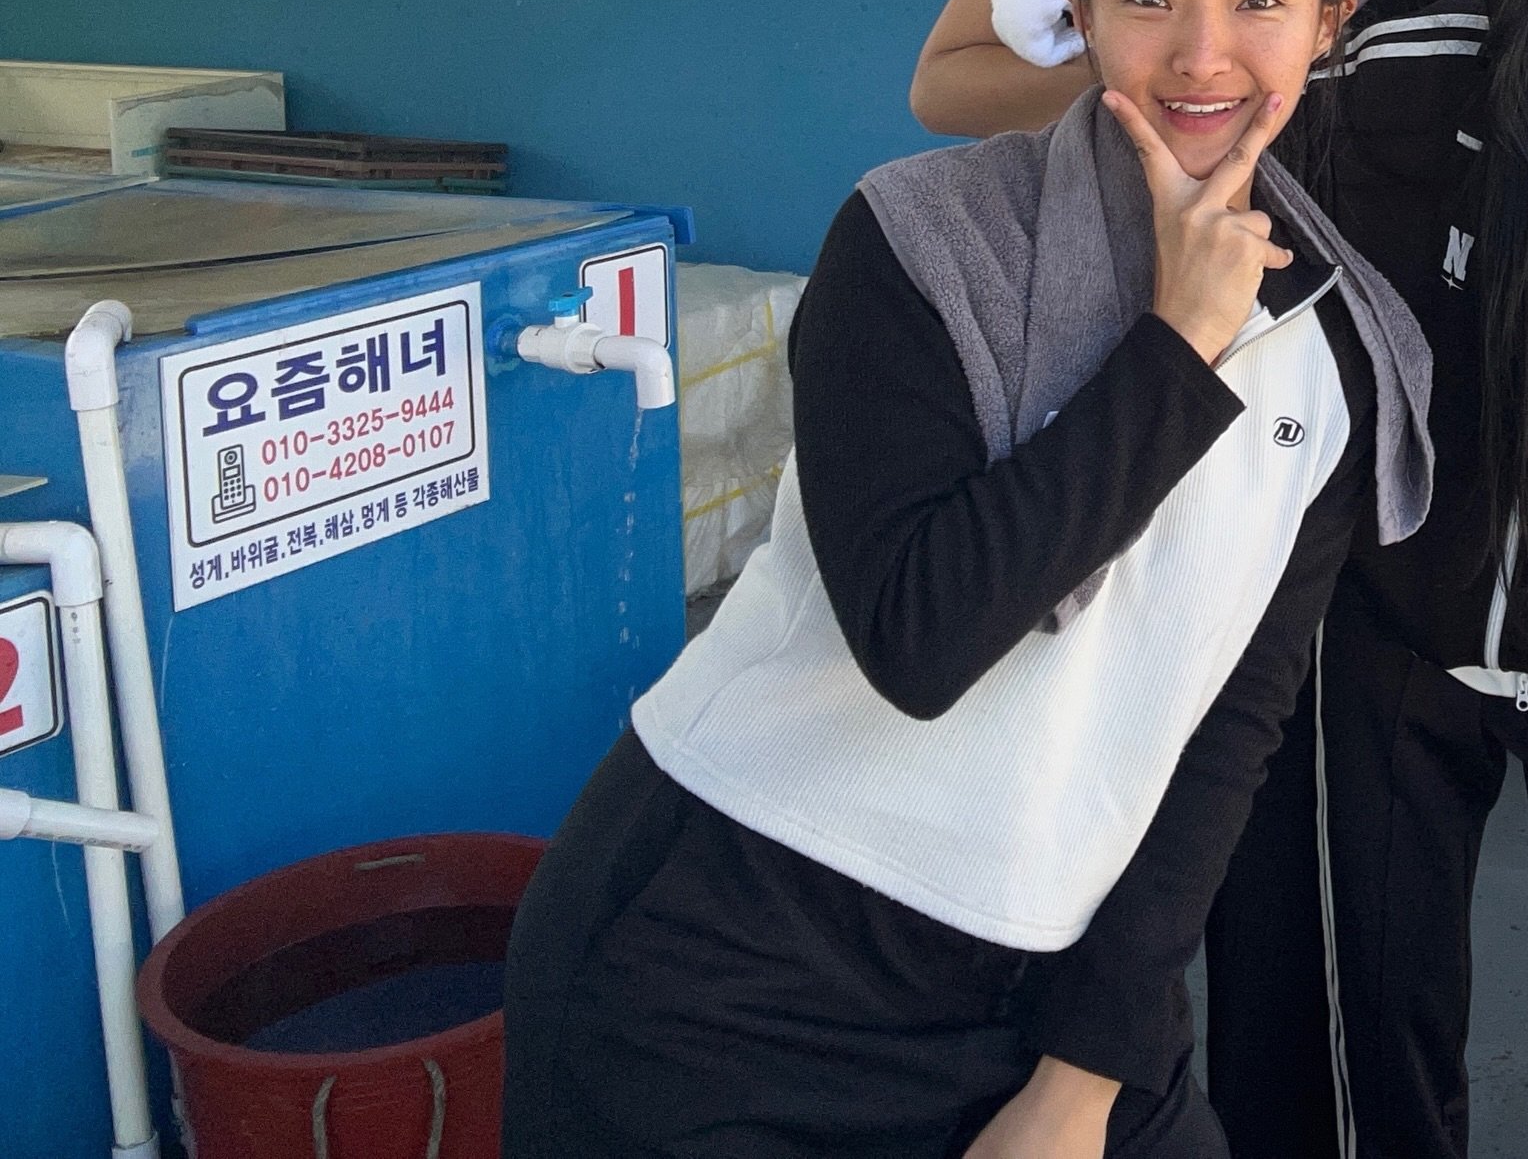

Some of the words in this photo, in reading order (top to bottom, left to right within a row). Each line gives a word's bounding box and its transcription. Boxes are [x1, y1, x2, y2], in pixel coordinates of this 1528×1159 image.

[1443, 225, 1475, 282] N
[203, 318, 446, 438] 요즘해녀
[261, 386, 455, 465] 010-3325-9444
[263, 420, 455, 502] 010-4208-0107
[394, 492, 408, 519] 등
[412, 467, 479, 510] 각종해산물
